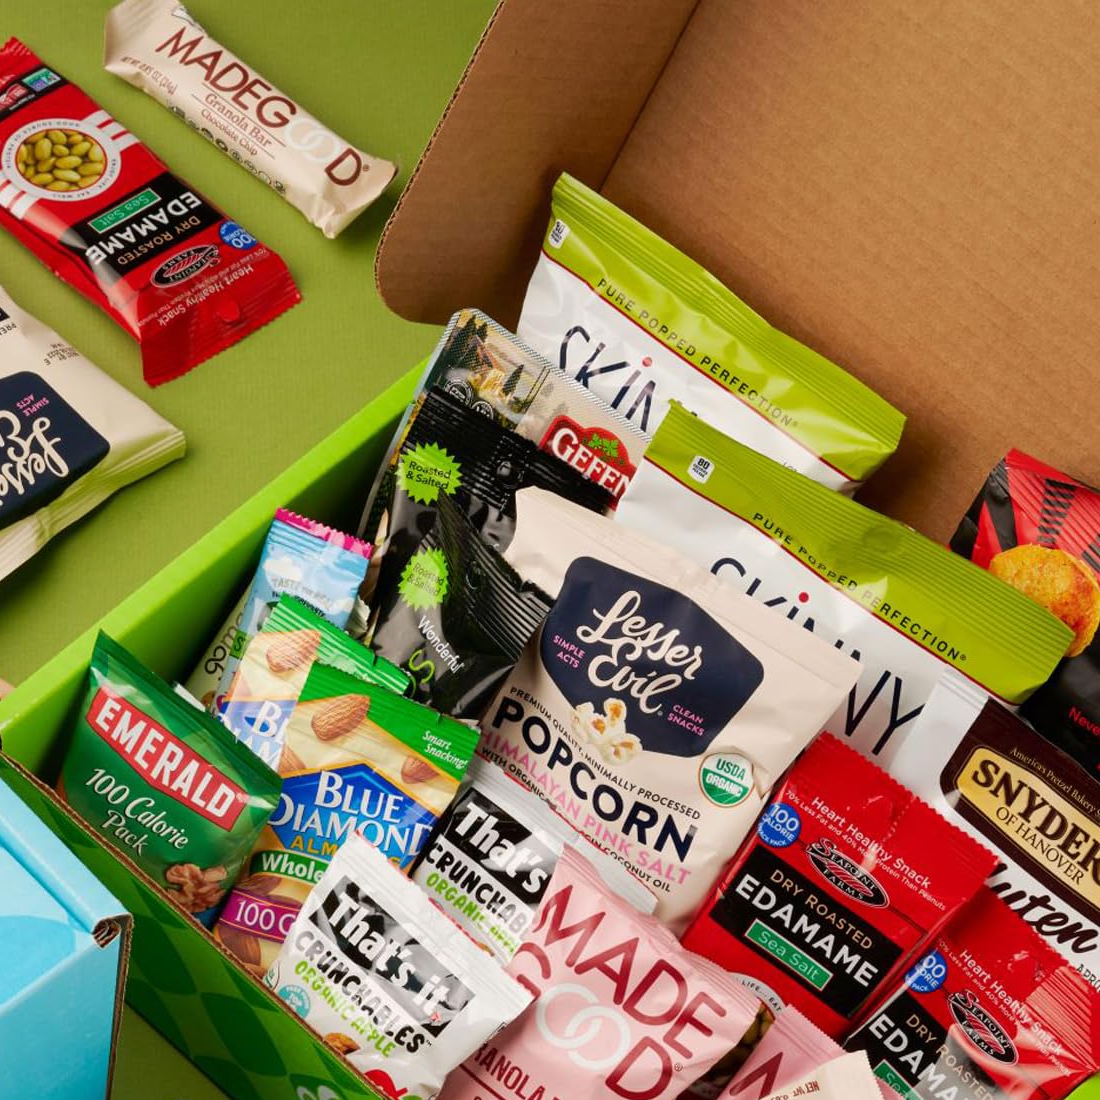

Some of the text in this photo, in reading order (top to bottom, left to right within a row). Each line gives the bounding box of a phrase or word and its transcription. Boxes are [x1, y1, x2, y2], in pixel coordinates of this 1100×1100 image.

[156, 27, 361, 185] MADEGOOD
[201, 109, 258, 156] Chocolate Chip
[205, 92, 272, 147] Granola Bar
[85, 191, 202, 265] EDAMAME
[117, 216, 201, 265] DRY ROASTED
[598, 278, 793, 427] PURE POPPED PERFECTION
[753, 512, 960, 661] PURE POPPED PERFECTION
[553, 634, 586, 659] SIMPLE
[556, 651, 580, 669] ACTS
[576, 590, 702, 680] Lesser
[587, 635, 681, 714] Evil
[422, 730, 452, 749] Smart
[667, 713, 705, 736] SNACKS
[672, 703, 704, 724] CLEAN
[95, 695, 238, 819] EMERALD
[424, 743, 468, 770] Snacking!
[491, 697, 698, 862] POPCORN
[716, 757, 746, 782] USDA
[86, 768, 189, 850] 100 Calorie
[101, 810, 149, 856] Pack
[315, 771, 404, 823] BLUE
[771, 805, 799, 831] 100
[583, 812, 691, 885] PINK SALT
[812, 797, 931, 888] Heart Healthy Snack
[995, 806, 1085, 885] OF HANOVER
[323, 893, 415, 993] That's
[735, 873, 878, 987] EDAMAME
[770, 870, 873, 949] DRY ROASTED
[294, 930, 426, 1053] CRUNCHABLES
[534, 884, 726, 1060] MADE
[758, 931, 819, 981] Sea Salt
